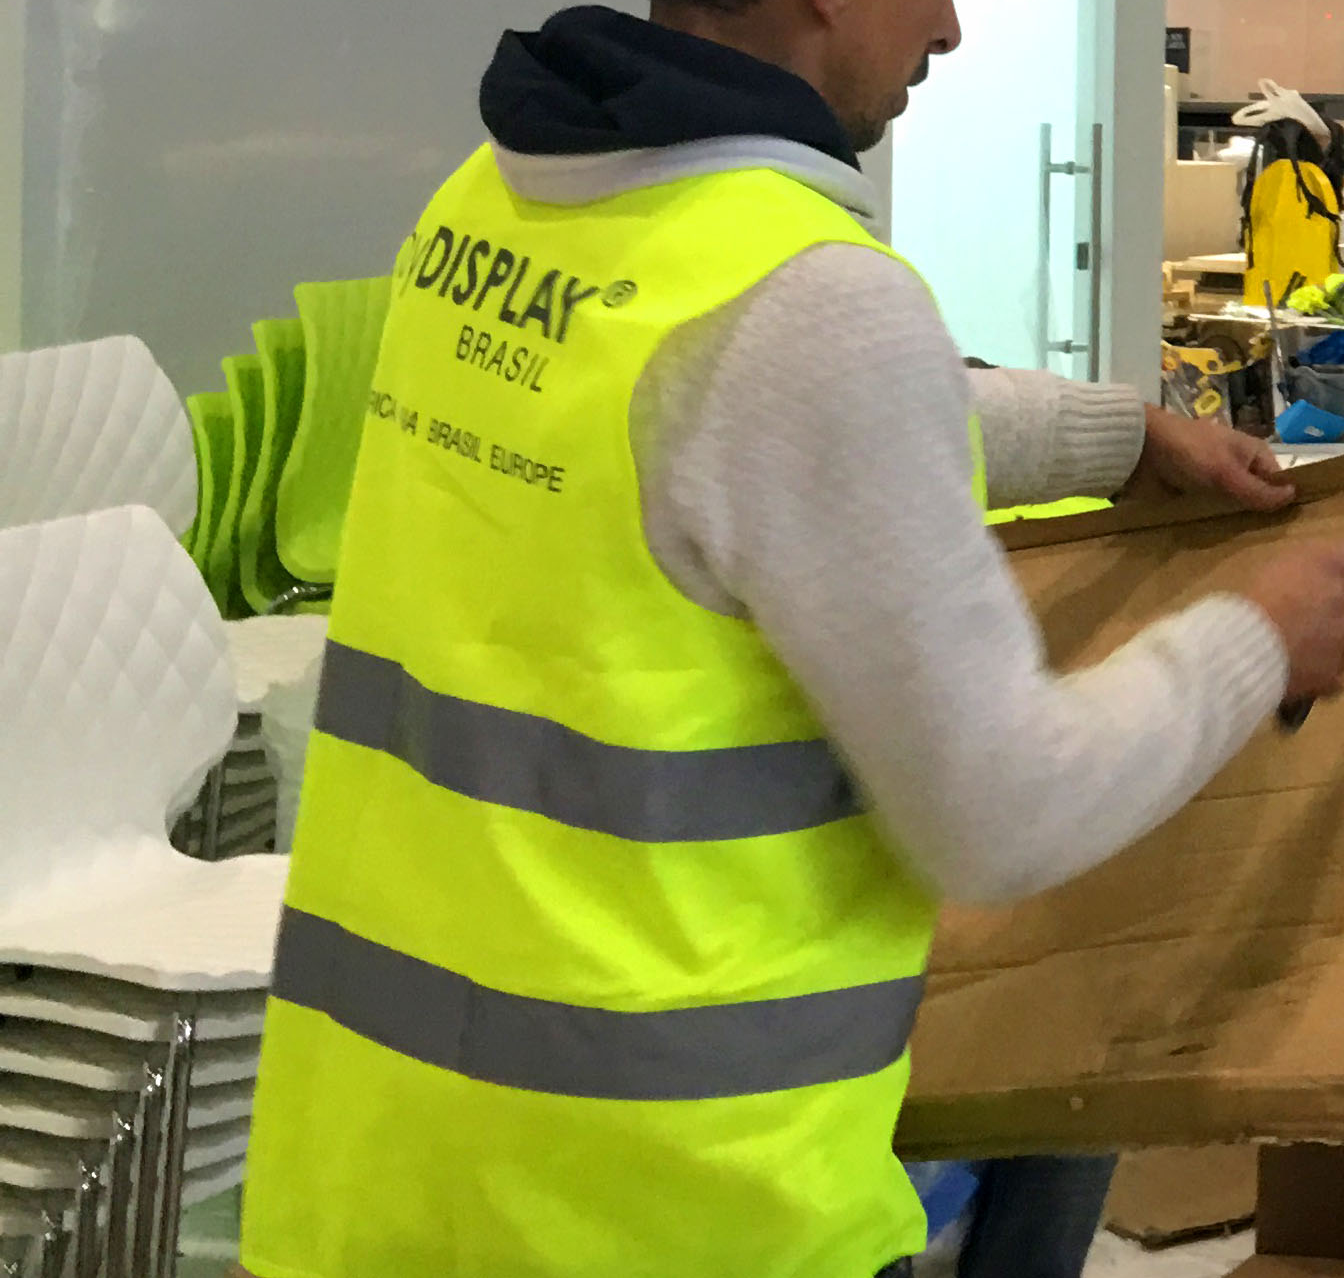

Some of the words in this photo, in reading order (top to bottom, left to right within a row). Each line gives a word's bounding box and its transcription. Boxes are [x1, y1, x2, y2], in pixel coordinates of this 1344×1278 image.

[455, 323, 550, 393] BRASIL
[426, 417, 482, 463] BRASIL
[488, 443, 566, 493] EUROPE
